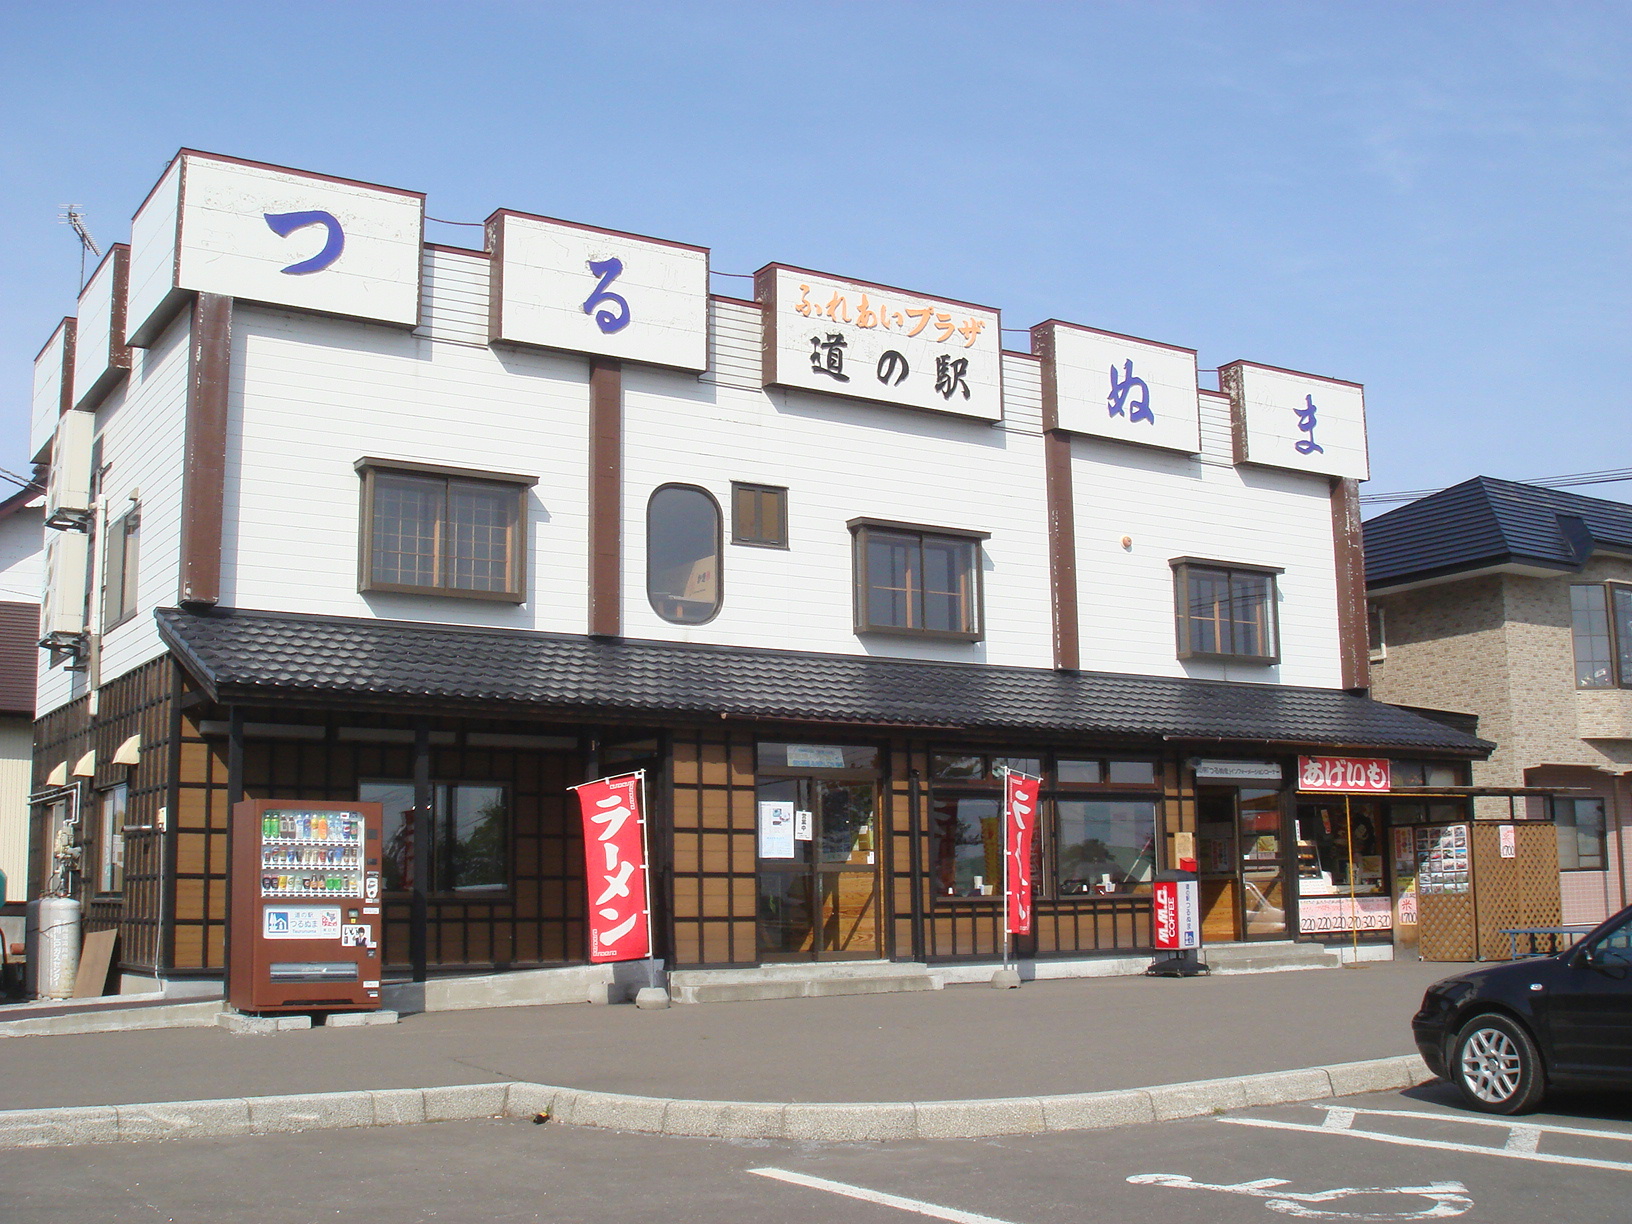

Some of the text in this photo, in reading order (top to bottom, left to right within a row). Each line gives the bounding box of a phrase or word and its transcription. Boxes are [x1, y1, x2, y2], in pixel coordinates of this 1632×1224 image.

[263, 209, 345, 276] つ
[582, 256, 631, 334] る
[794, 283, 986, 349] ふれあいプラザ
[809, 331, 971, 401] 道の駅
[1106, 357, 1155, 426] ぬ
[1292, 393, 1325, 455] ま
[1302, 758, 1387, 789] あげいも
[590, 794, 637, 947] ラーメン
[290, 919, 318, 928] つるぬま
[1168, 896, 1176, 938] COFFEE
[1301, 918, 1316, 931] 220
[1318, 916, 1331, 930] 220
